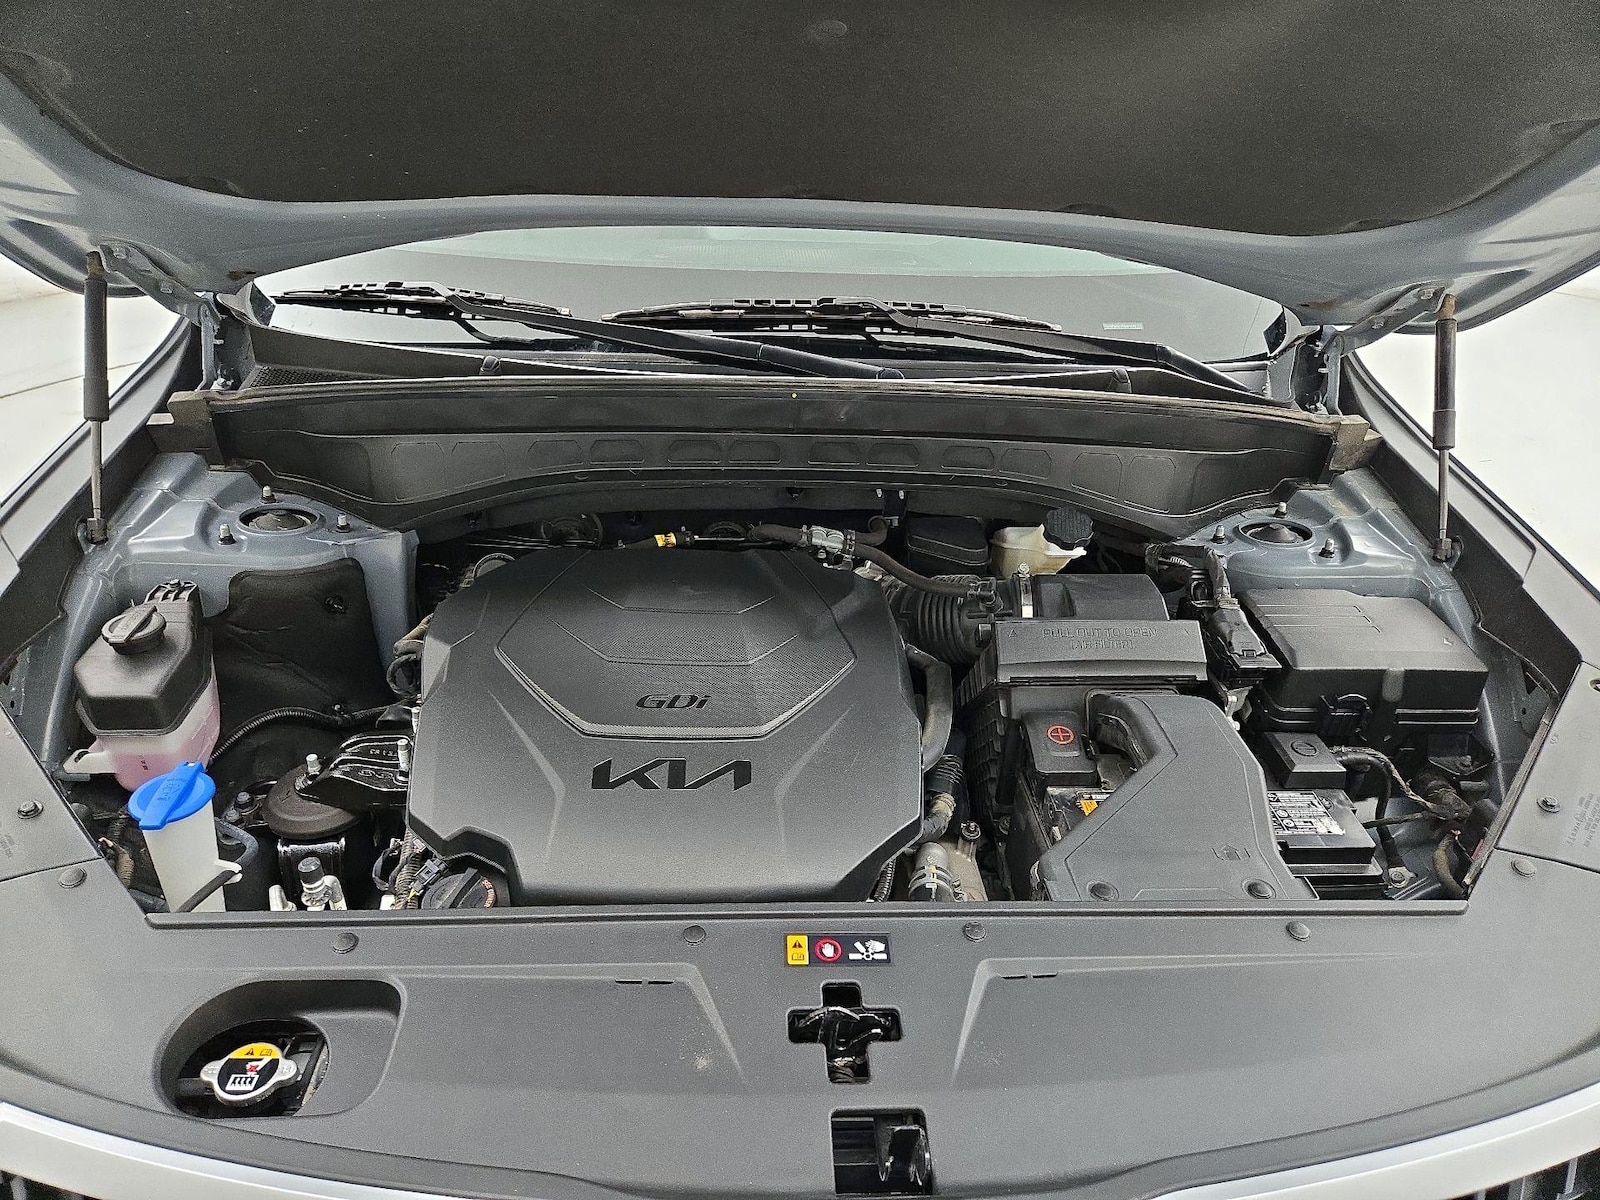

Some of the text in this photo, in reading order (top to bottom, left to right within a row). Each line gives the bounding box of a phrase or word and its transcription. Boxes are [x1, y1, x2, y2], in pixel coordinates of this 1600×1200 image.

[1042, 627, 1158, 639] PULL OUT TO OPEN
[636, 694, 711, 709] GDi
[591, 758, 752, 792] KIA
